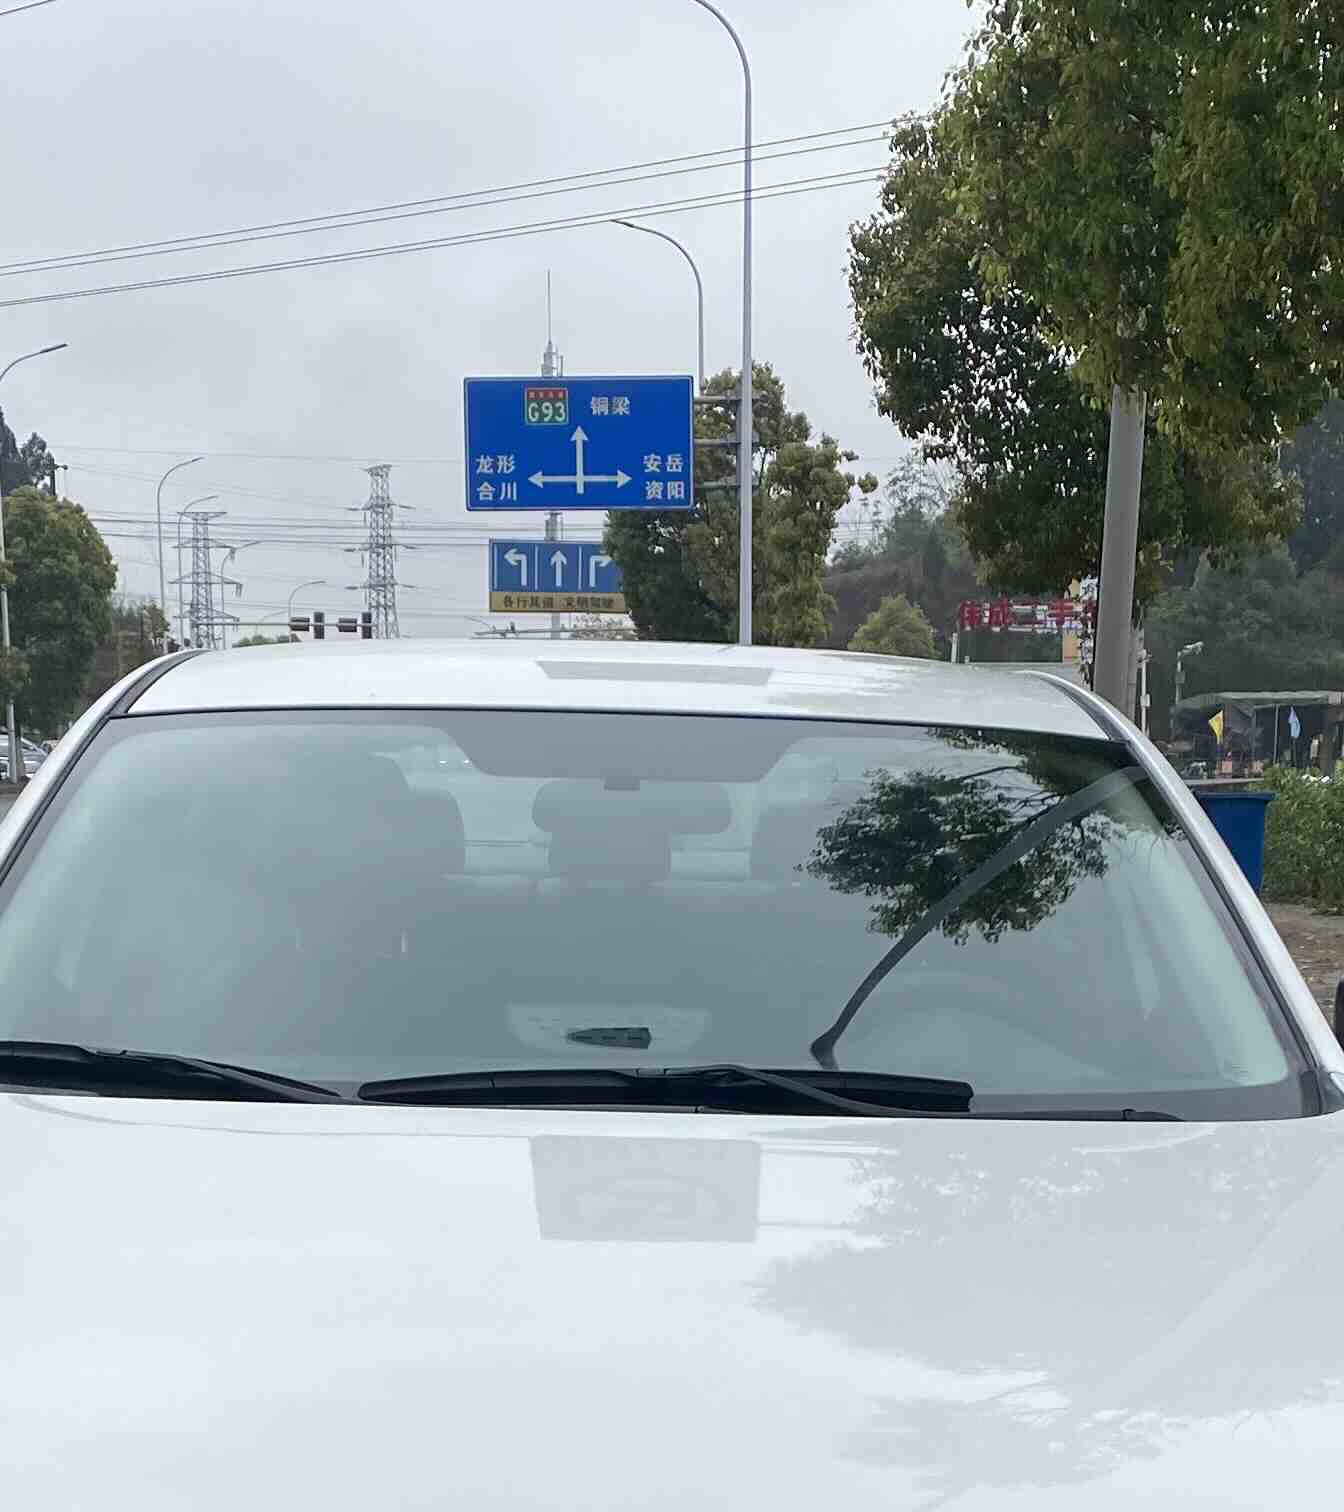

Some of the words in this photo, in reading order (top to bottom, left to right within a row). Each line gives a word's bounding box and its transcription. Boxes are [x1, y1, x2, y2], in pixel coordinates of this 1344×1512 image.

[528, 402, 565, 422] G93
[590, 396, 630, 417] 铜梁
[475, 454, 515, 475] 龙形
[643, 453, 684, 473] 安岳
[476, 481, 517, 501] 合川
[645, 480, 685, 500] 资阳
